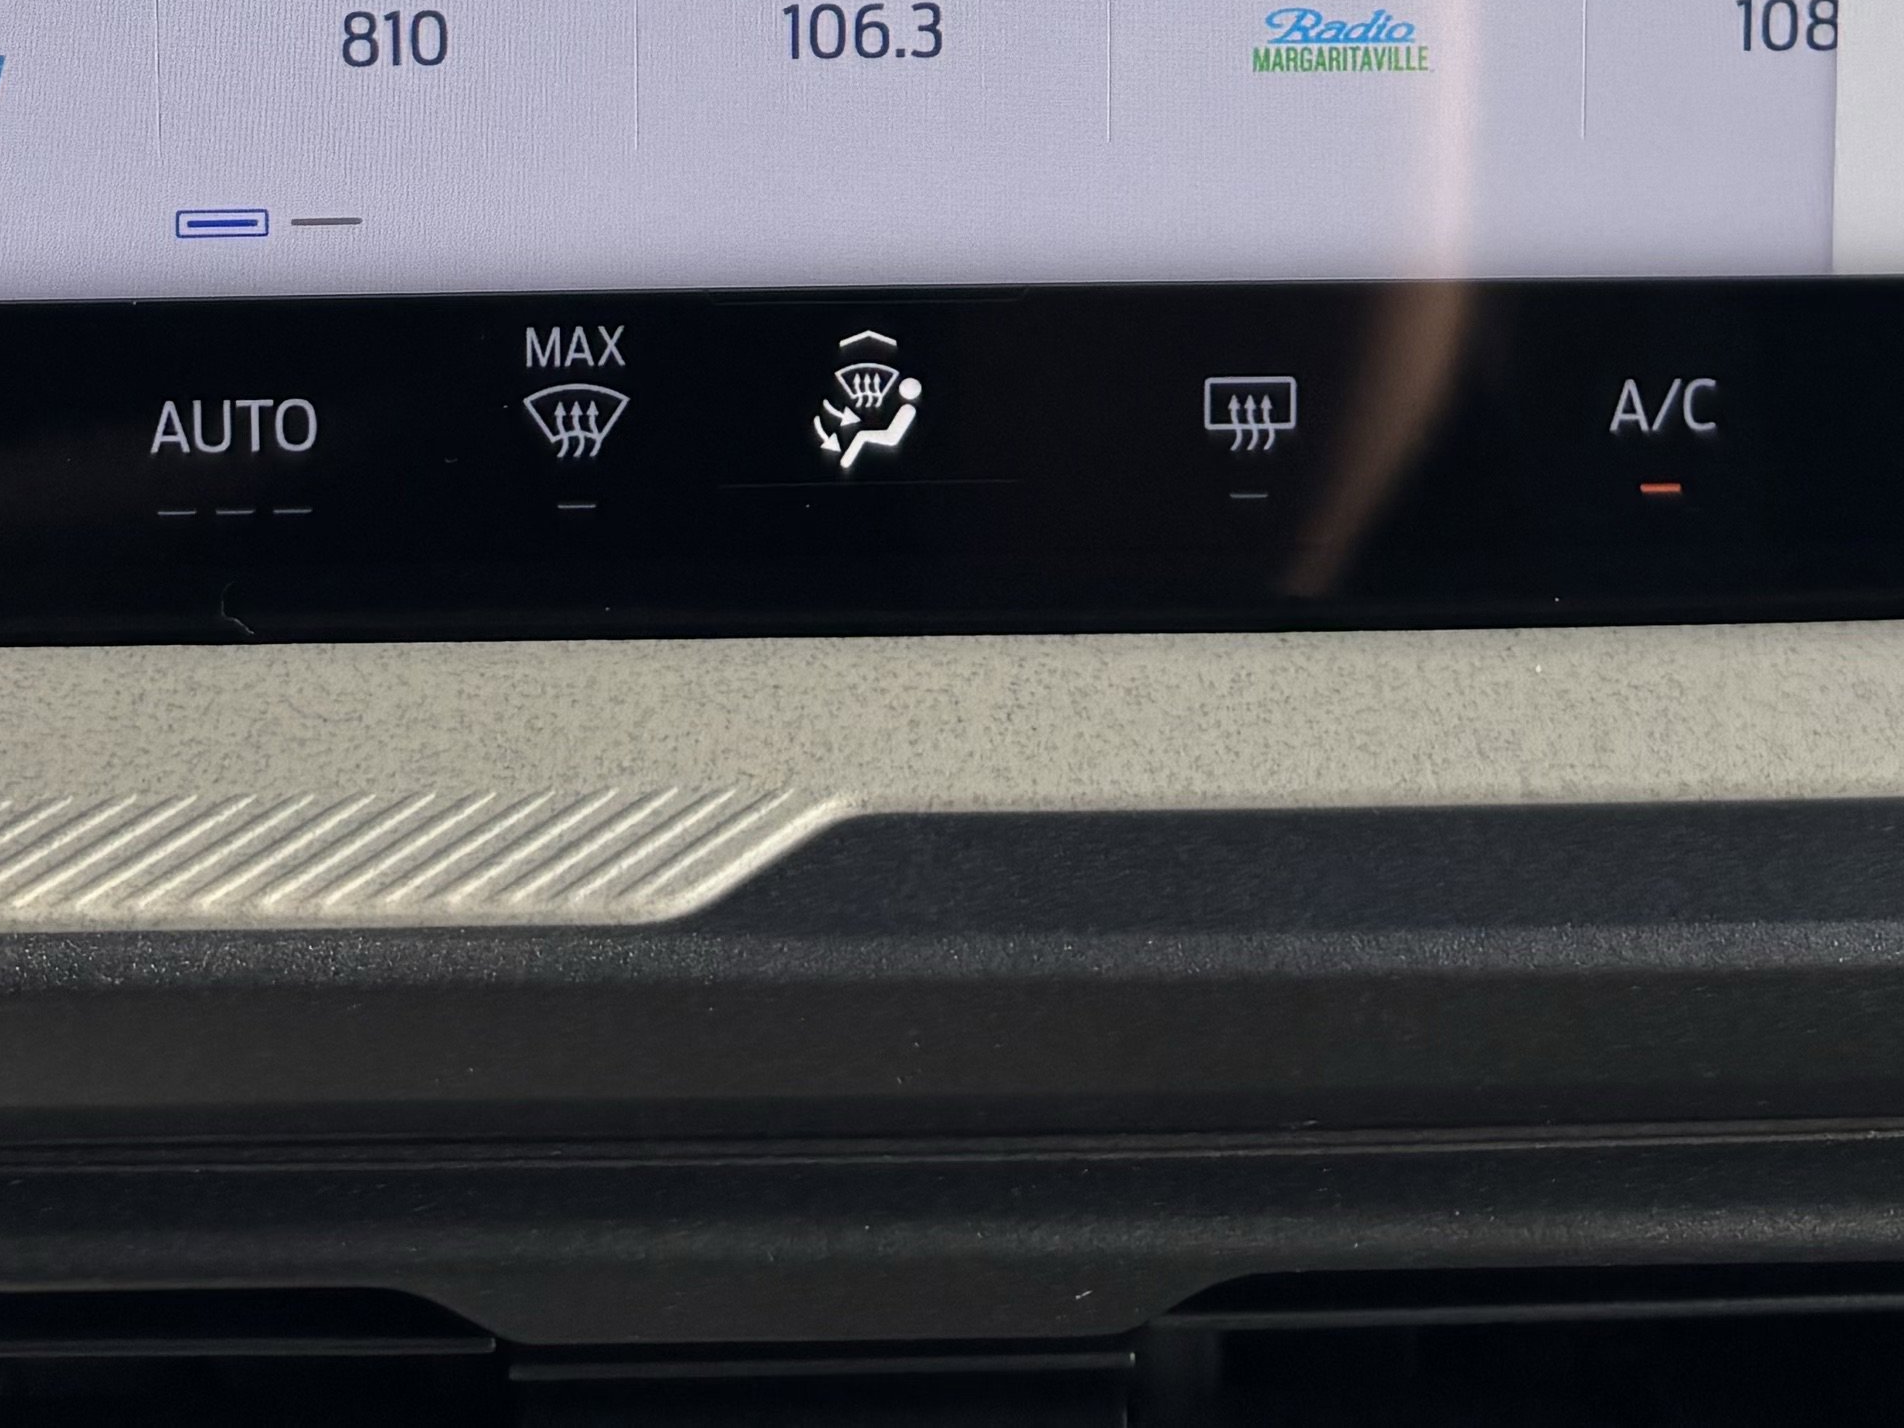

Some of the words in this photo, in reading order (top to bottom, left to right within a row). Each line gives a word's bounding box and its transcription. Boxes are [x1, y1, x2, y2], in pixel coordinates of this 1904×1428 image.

[341, 9, 448, 68] 810
[783, 1, 943, 60] 106.3
[1264, 6, 1418, 44] Radio
[1252, 45, 1430, 73] MARGARITAVILLE
[525, 325, 626, 368] MAX
[150, 398, 318, 454] AUTO
[1609, 377, 1717, 433] A/C
